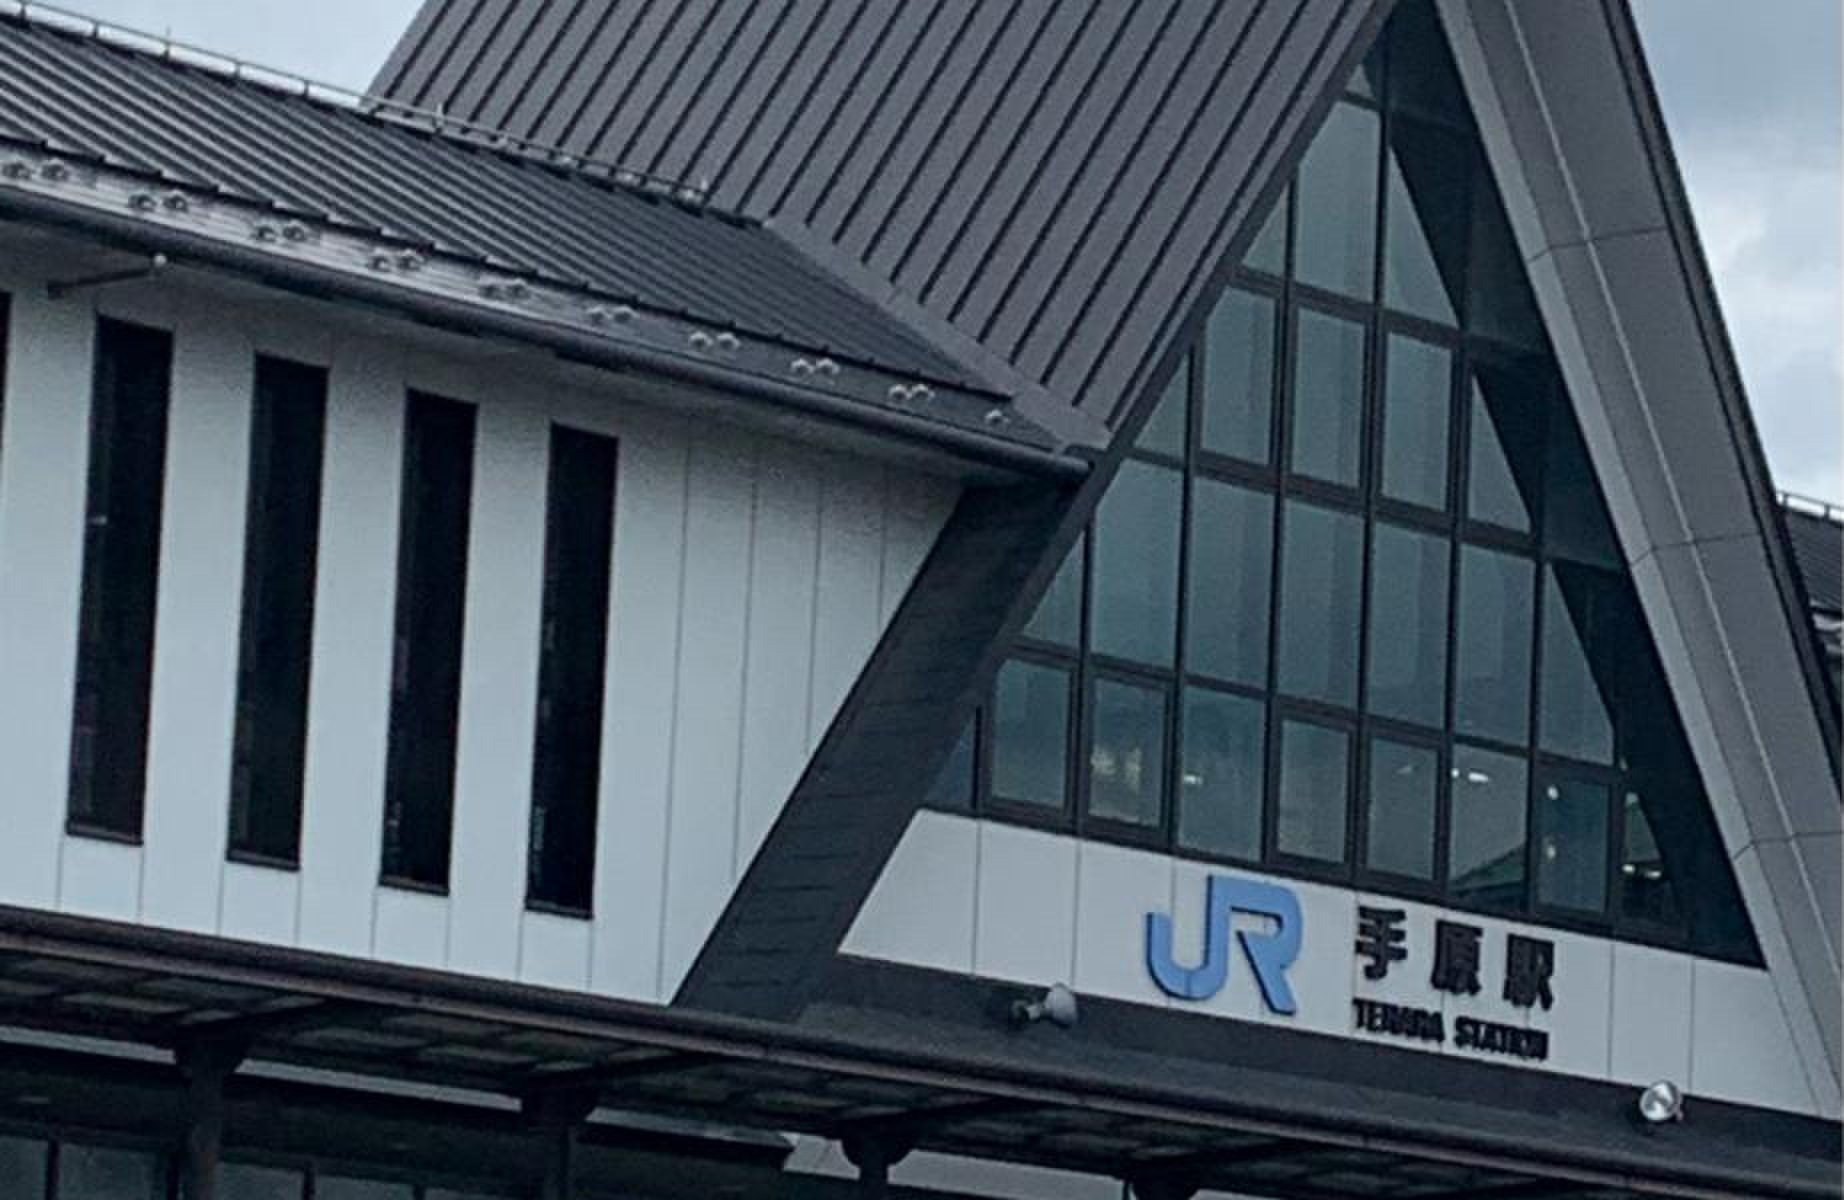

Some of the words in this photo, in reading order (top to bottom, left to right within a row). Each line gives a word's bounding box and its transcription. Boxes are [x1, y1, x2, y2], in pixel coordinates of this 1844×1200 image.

[1146, 874, 1304, 1016] JR
[1354, 904, 1556, 1010] 手原駅
